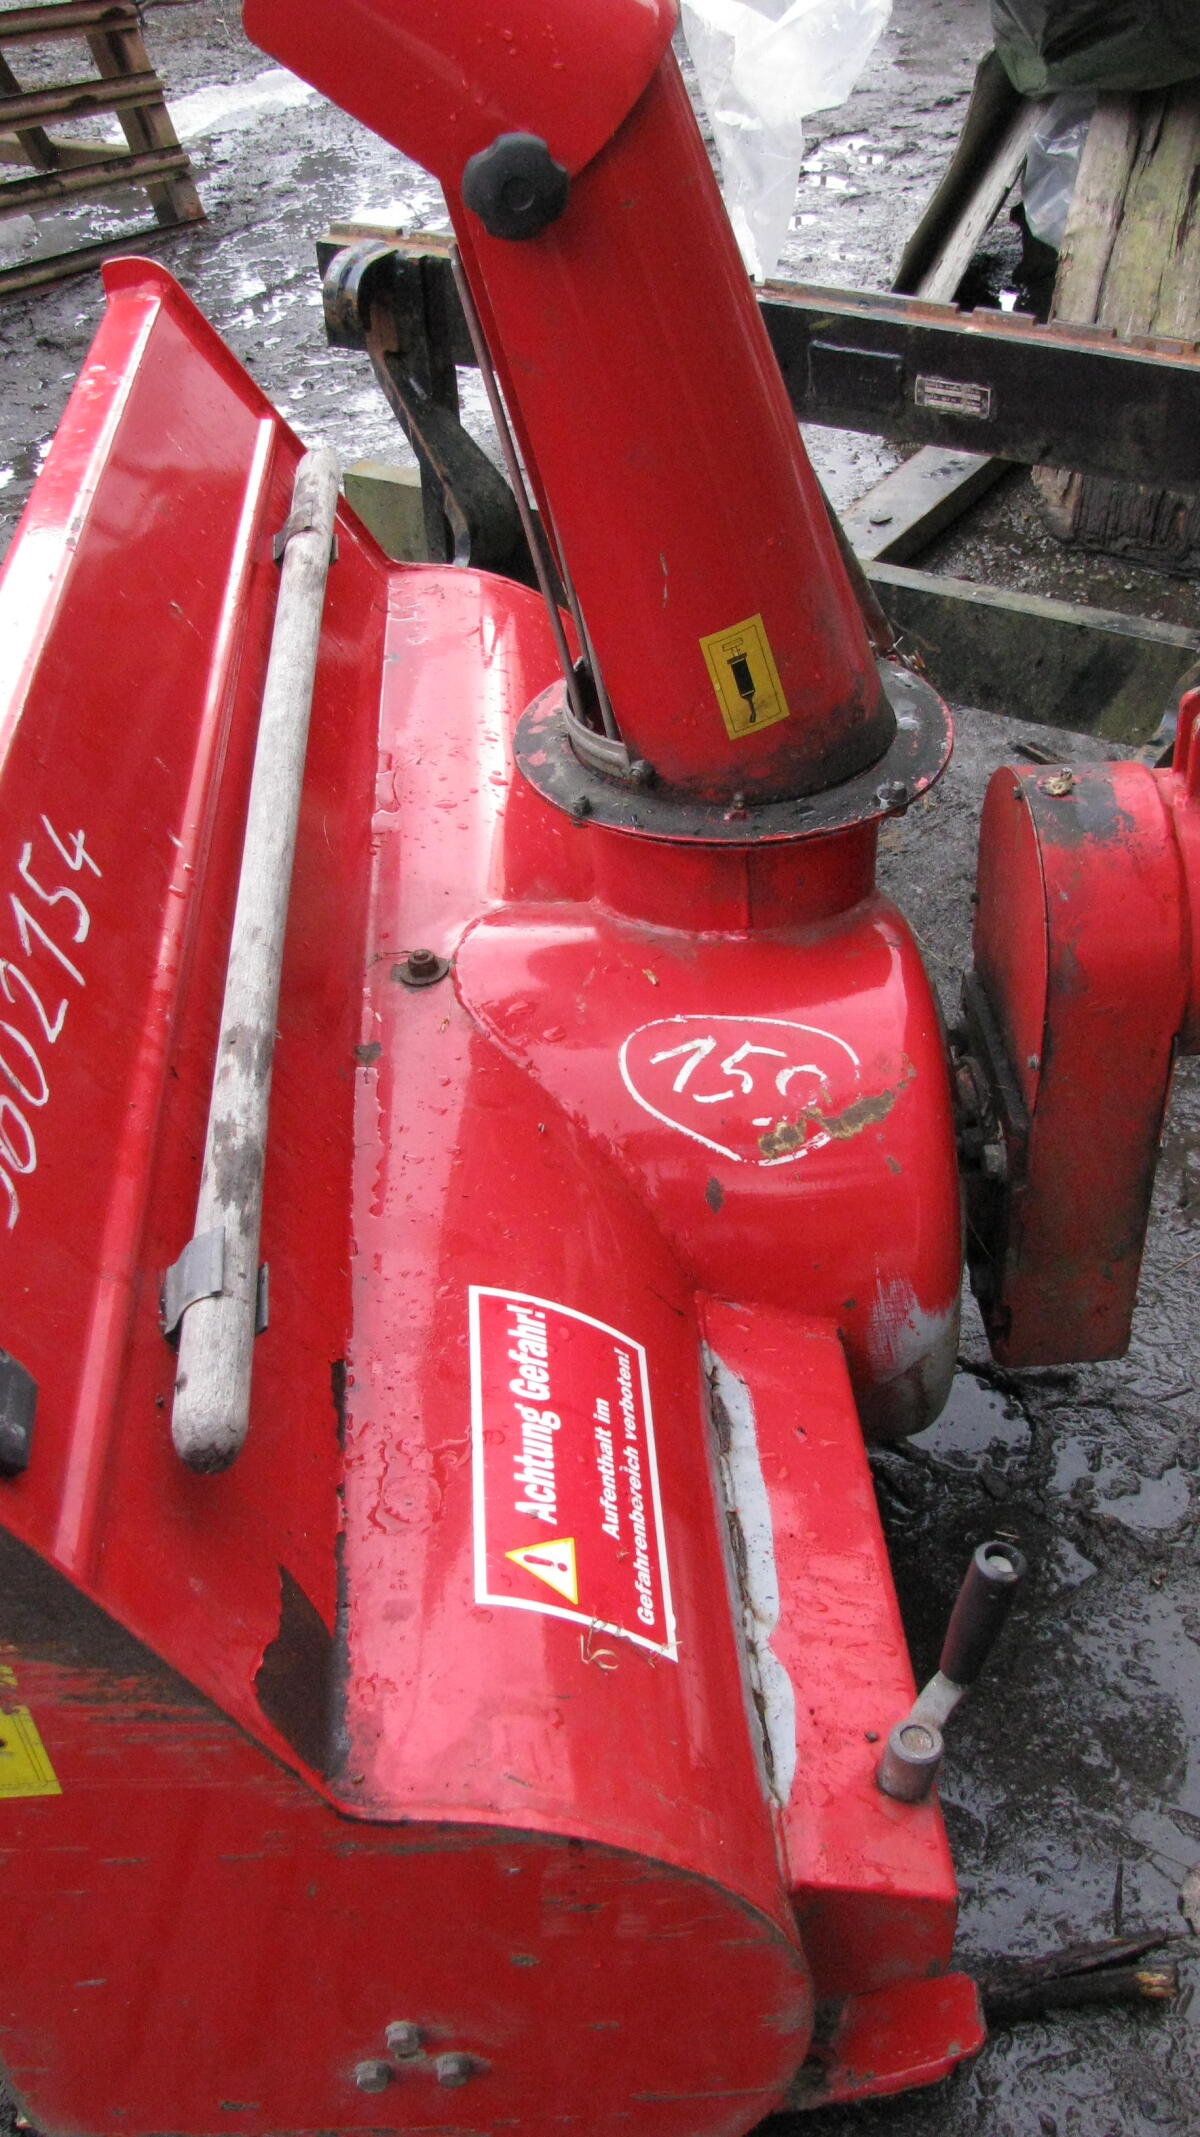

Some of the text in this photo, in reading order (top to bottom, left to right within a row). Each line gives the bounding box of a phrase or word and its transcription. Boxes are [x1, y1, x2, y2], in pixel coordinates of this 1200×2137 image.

[506, 1303, 562, 1525] Achtung Gefahr!
[592, 1397, 620, 1541] Aufenthalt im
[613, 1347, 655, 1626] Gefahrenbereich verboten!
